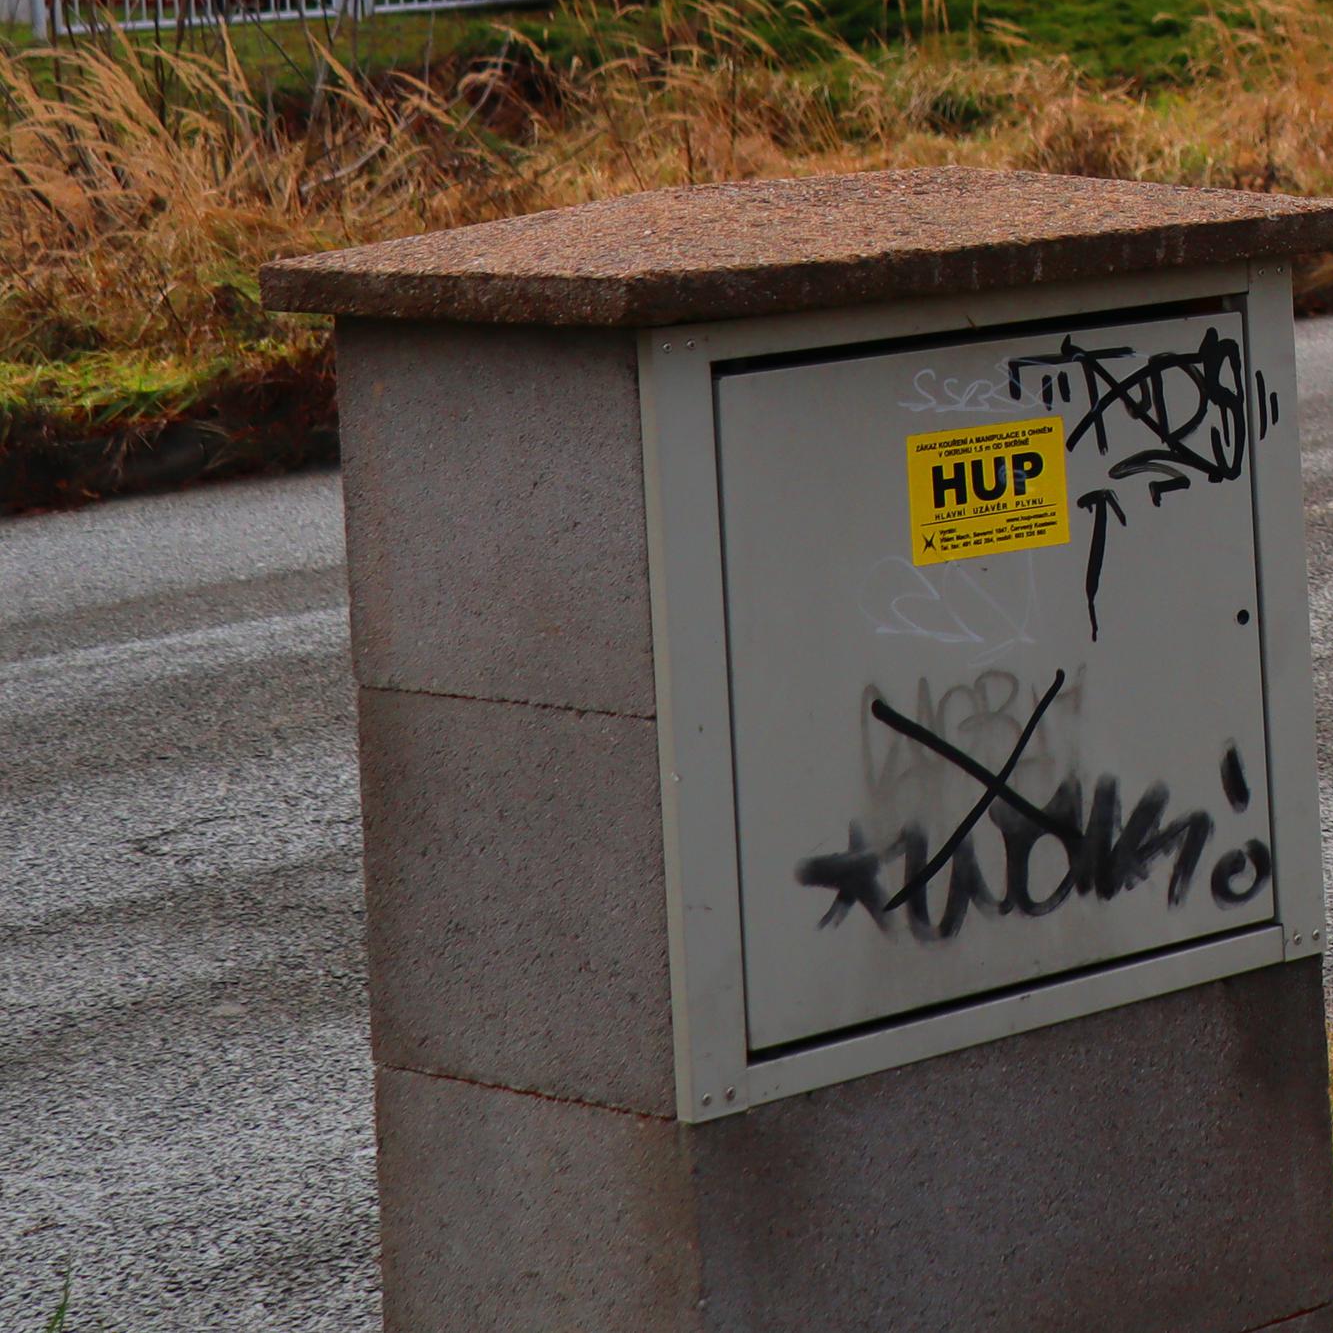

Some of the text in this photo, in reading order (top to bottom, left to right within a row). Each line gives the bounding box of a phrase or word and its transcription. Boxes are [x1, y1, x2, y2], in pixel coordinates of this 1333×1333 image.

[916, 442, 937, 452] ZÁKAZ
[938, 437, 968, 448] KOUŘENÍ
[976, 431, 1019, 443] MANIPULACE
[1028, 426, 1053, 436] OHNĚM
[944, 447, 972, 456] OKRUHU
[991, 441, 1003, 449] OD
[931, 452, 1044, 509] HUP
[935, 499, 1044, 520] HLAVNÍ UZÁVĚR PLYNU
